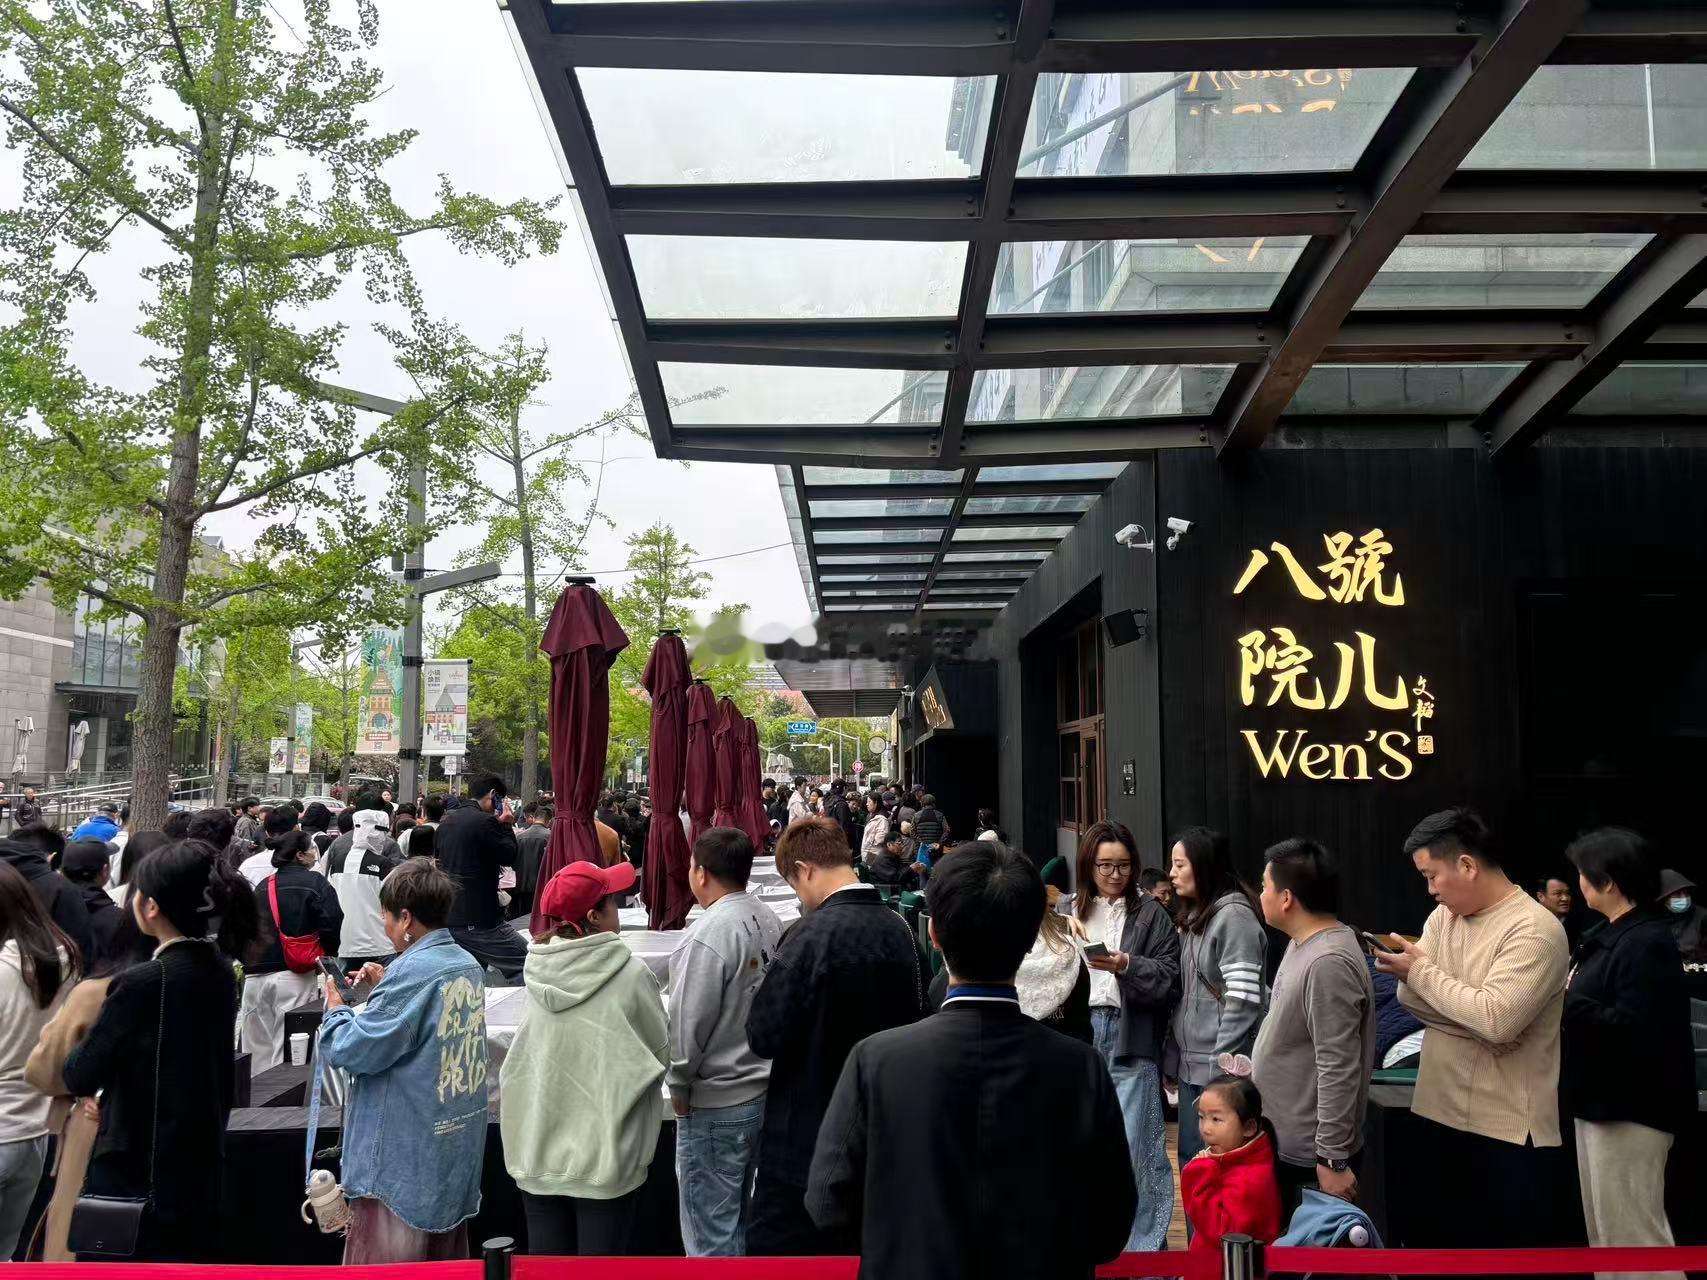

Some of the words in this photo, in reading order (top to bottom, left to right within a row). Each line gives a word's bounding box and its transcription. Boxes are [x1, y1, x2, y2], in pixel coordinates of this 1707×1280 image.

[1233, 528, 1405, 606] 八號
[1238, 627, 1409, 710] 院儿
[1240, 729, 1412, 780] Wen'S
[437, 1062, 488, 1104] PRID
